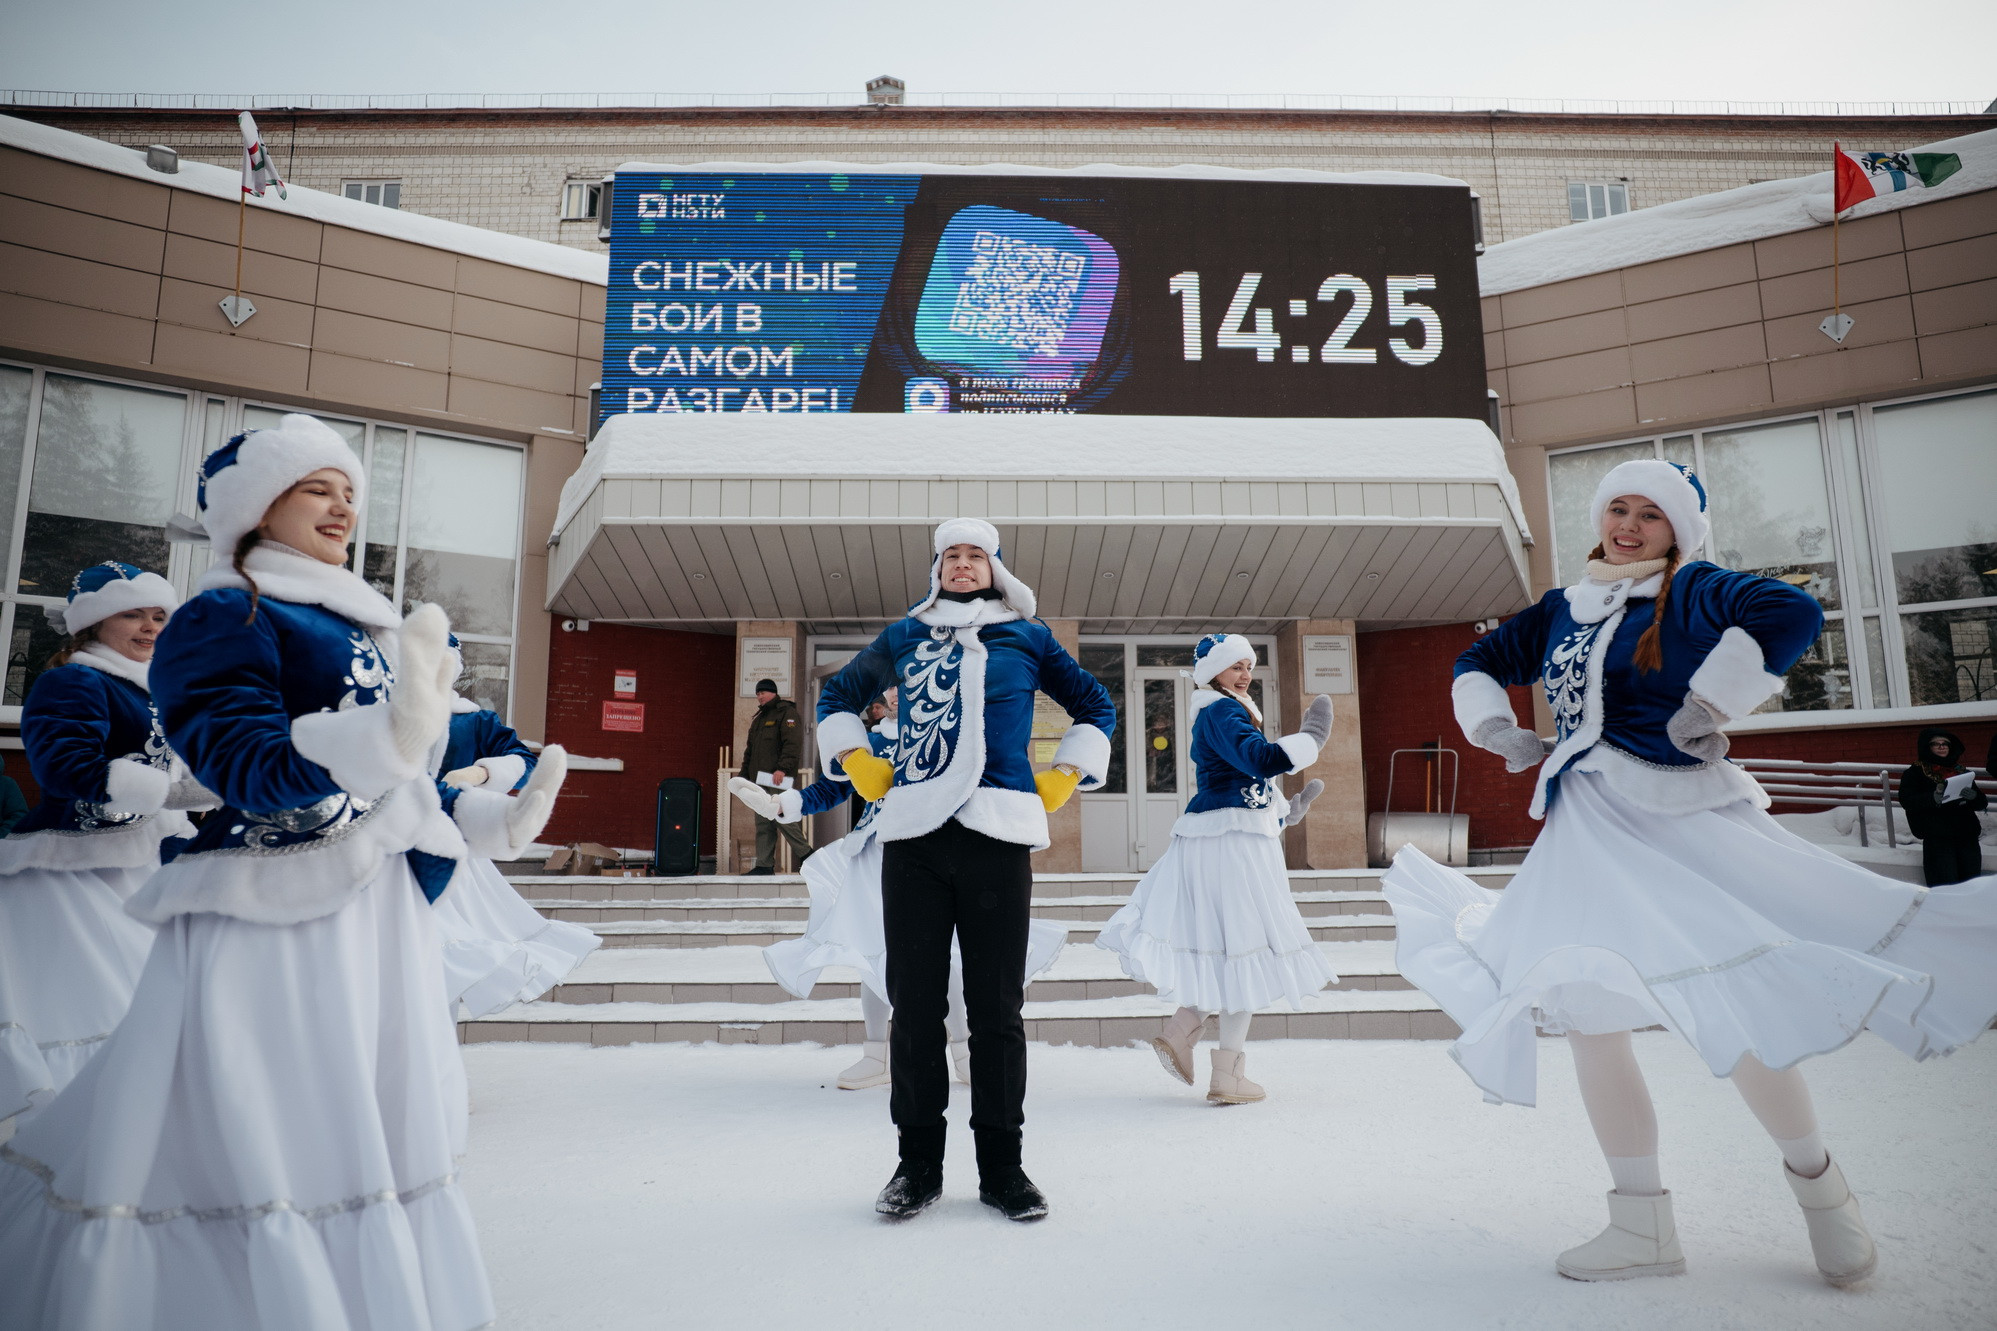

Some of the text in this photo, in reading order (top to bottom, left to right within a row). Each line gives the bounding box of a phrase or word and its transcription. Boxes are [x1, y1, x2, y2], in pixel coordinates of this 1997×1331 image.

[672, 194, 725, 205] НГТУ
[633, 261, 858, 291] СНЕЖНЫЕ
[631, 302, 763, 333] БОИ В
[1169, 271, 1444, 366] 14:25
[628, 345, 795, 376] САМОМ
